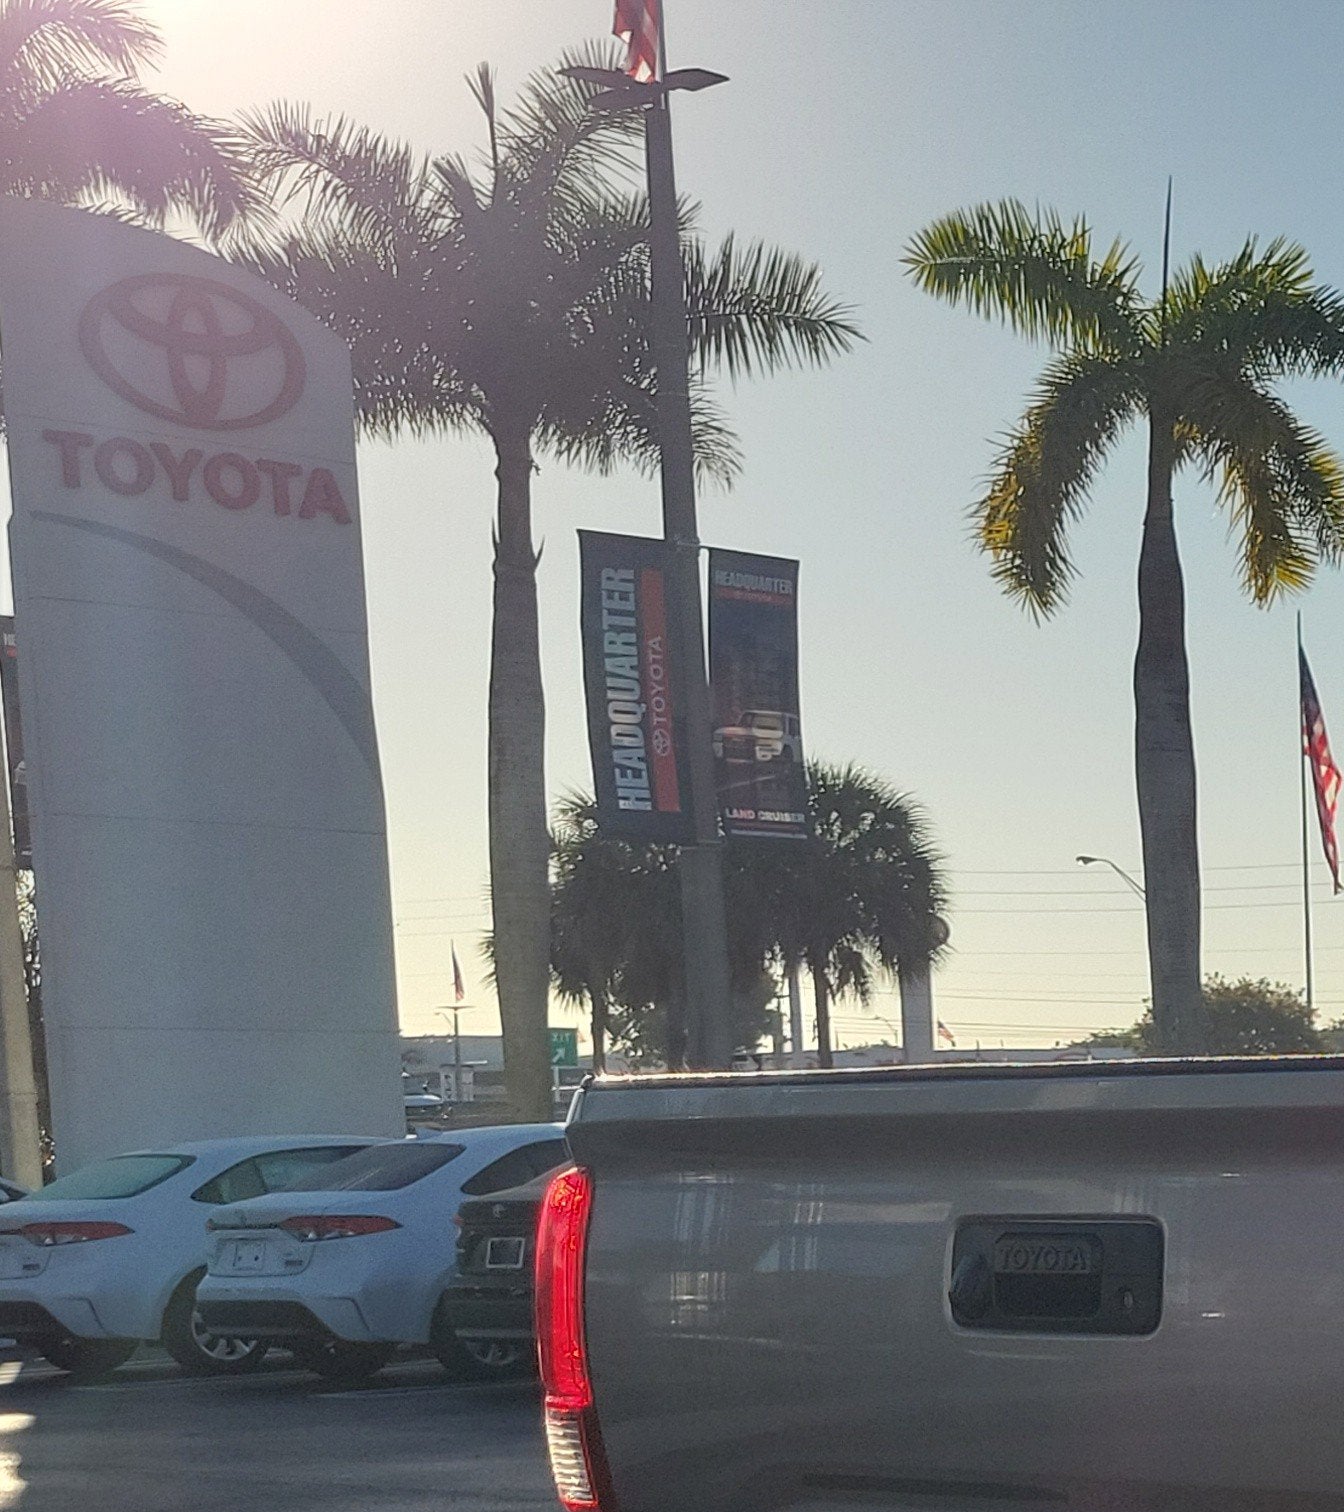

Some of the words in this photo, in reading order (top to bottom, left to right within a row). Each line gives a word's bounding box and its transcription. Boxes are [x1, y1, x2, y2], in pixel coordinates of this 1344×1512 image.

[41, 428, 352, 525] TOYOTA
[600, 567, 652, 811] HEADQUARTER
[648, 635, 667, 726] TOYOTA
[725, 808, 756, 819] LAND
[1001, 1246, 1088, 1271] TOYOTA
